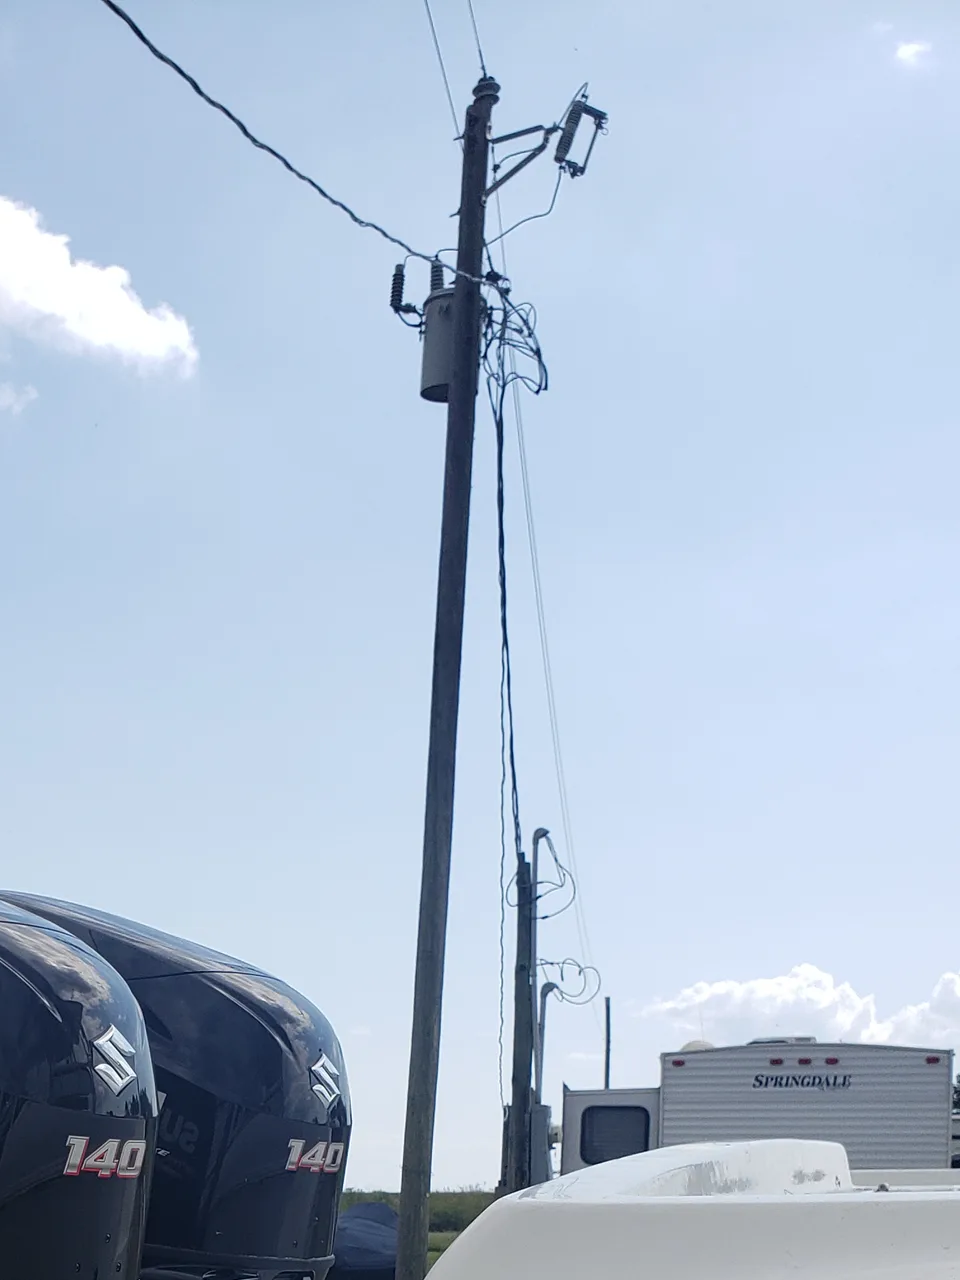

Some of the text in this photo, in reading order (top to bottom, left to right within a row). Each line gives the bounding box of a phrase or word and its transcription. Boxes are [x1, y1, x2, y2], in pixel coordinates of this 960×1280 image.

[752, 1073, 852, 1090] SPRINGDALE
[63, 1135, 147, 1178] 140
[285, 1138, 345, 1172] 140
